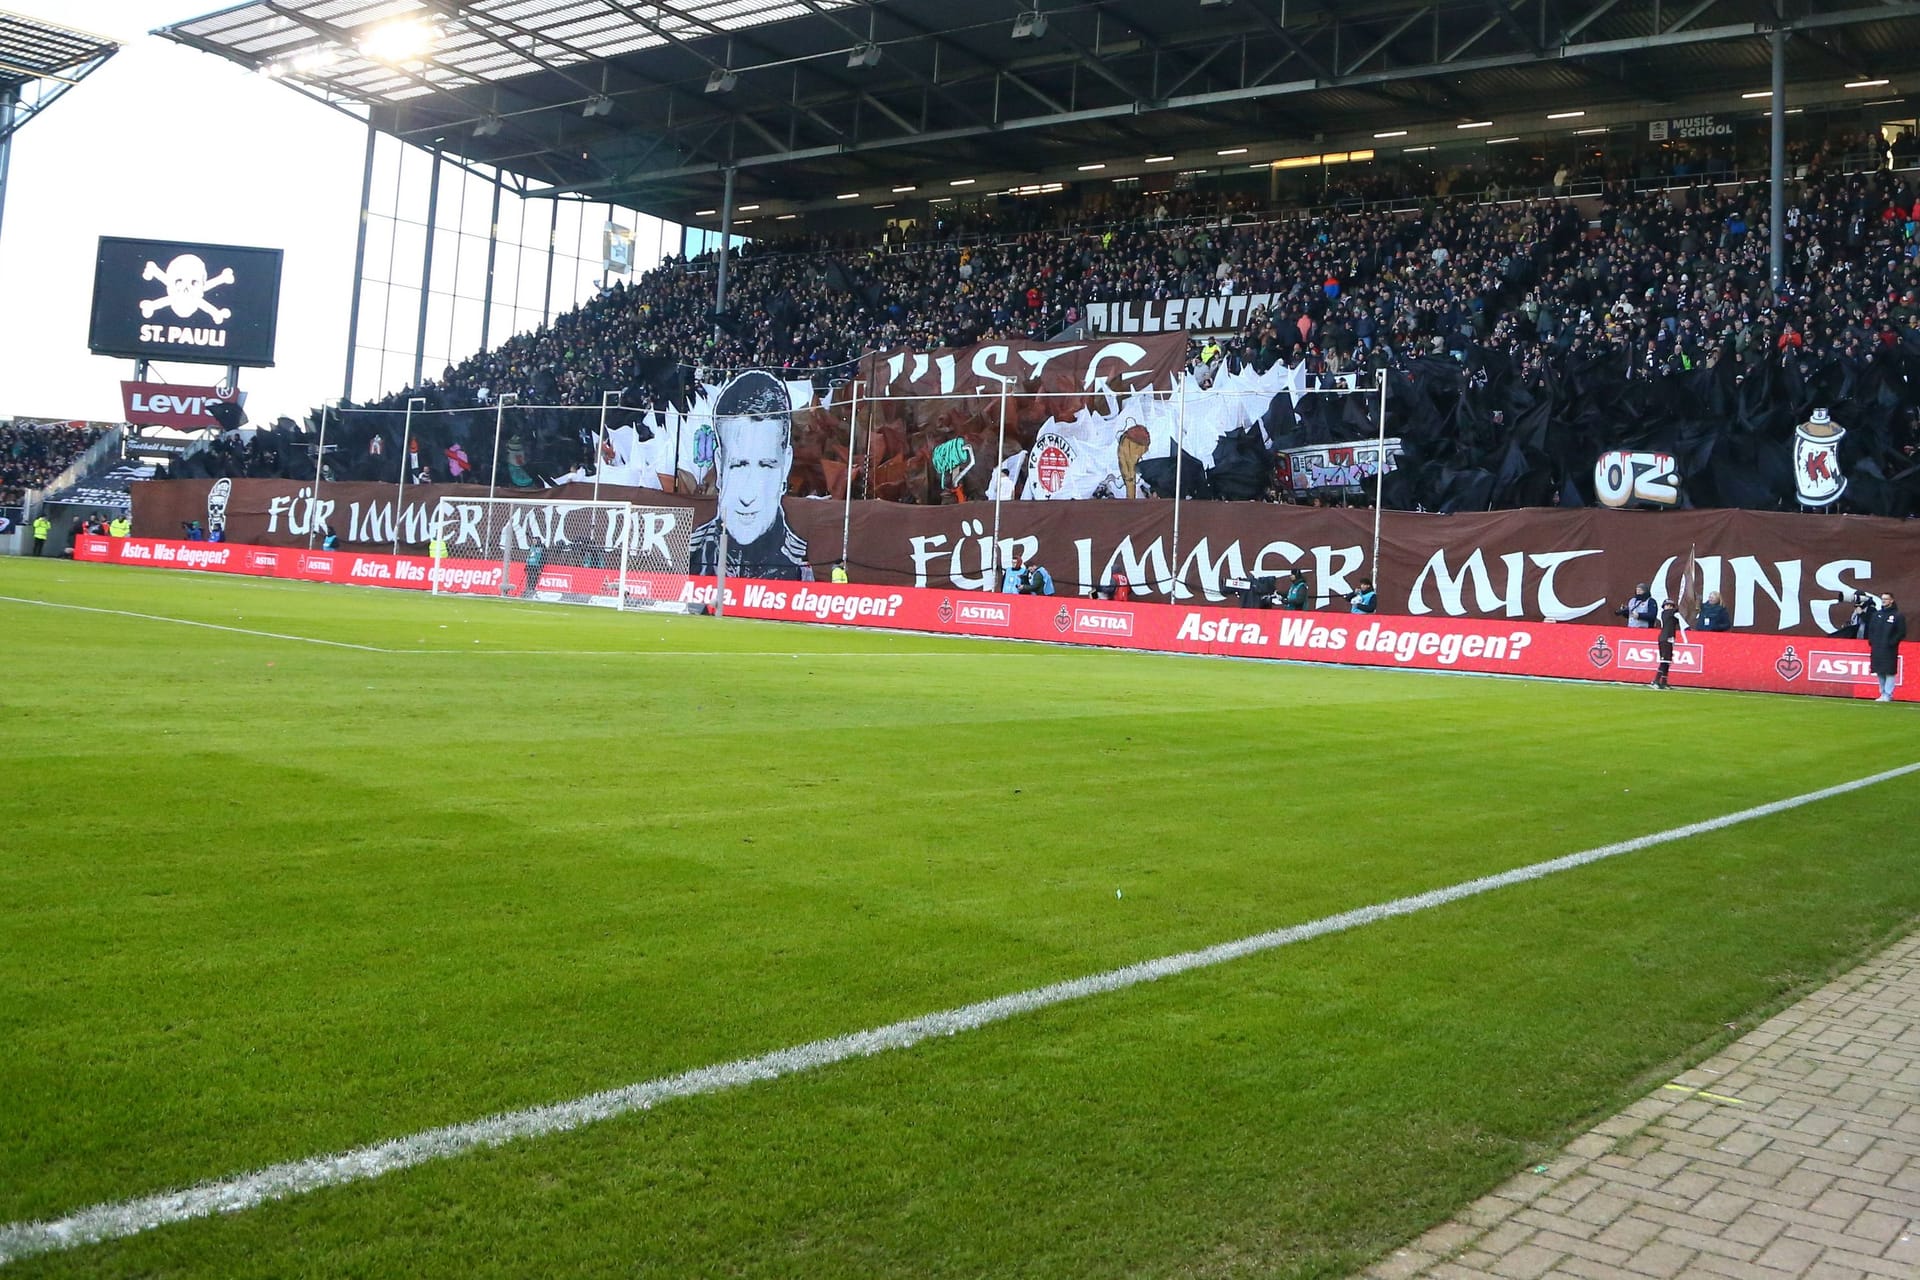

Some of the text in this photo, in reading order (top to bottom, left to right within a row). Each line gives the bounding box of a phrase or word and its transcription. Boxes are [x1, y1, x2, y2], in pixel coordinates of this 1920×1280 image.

[1672, 116, 1715, 129] MUSIC
[1680, 124, 1733, 138] SCHOOL
[139, 324, 227, 347] ST. PAULI
[1804, 450, 1832, 489] K
[266, 486, 335, 536] FÜR
[348, 499, 483, 553] IMMER
[605, 508, 676, 567] DIR
[121, 541, 230, 567] Astra. Was dagegen?
[254, 556, 277, 566] ASTRA
[307, 560, 332, 572] ASTRA
[351, 558, 392, 579] Astra.
[395, 560, 425, 581] Was
[539, 577, 569, 589] ASTRA
[909, 518, 1884, 636] FÜR IMMER MIT UNS
[624, 584, 649, 595] STRA
[743, 584, 787, 610] Was
[791, 588, 904, 620] dagegen?
[960, 606, 1006, 621] ASTRA
[1079, 614, 1128, 631] ASTRA
[1177, 613, 1532, 665] Astra. Was dagegen?
